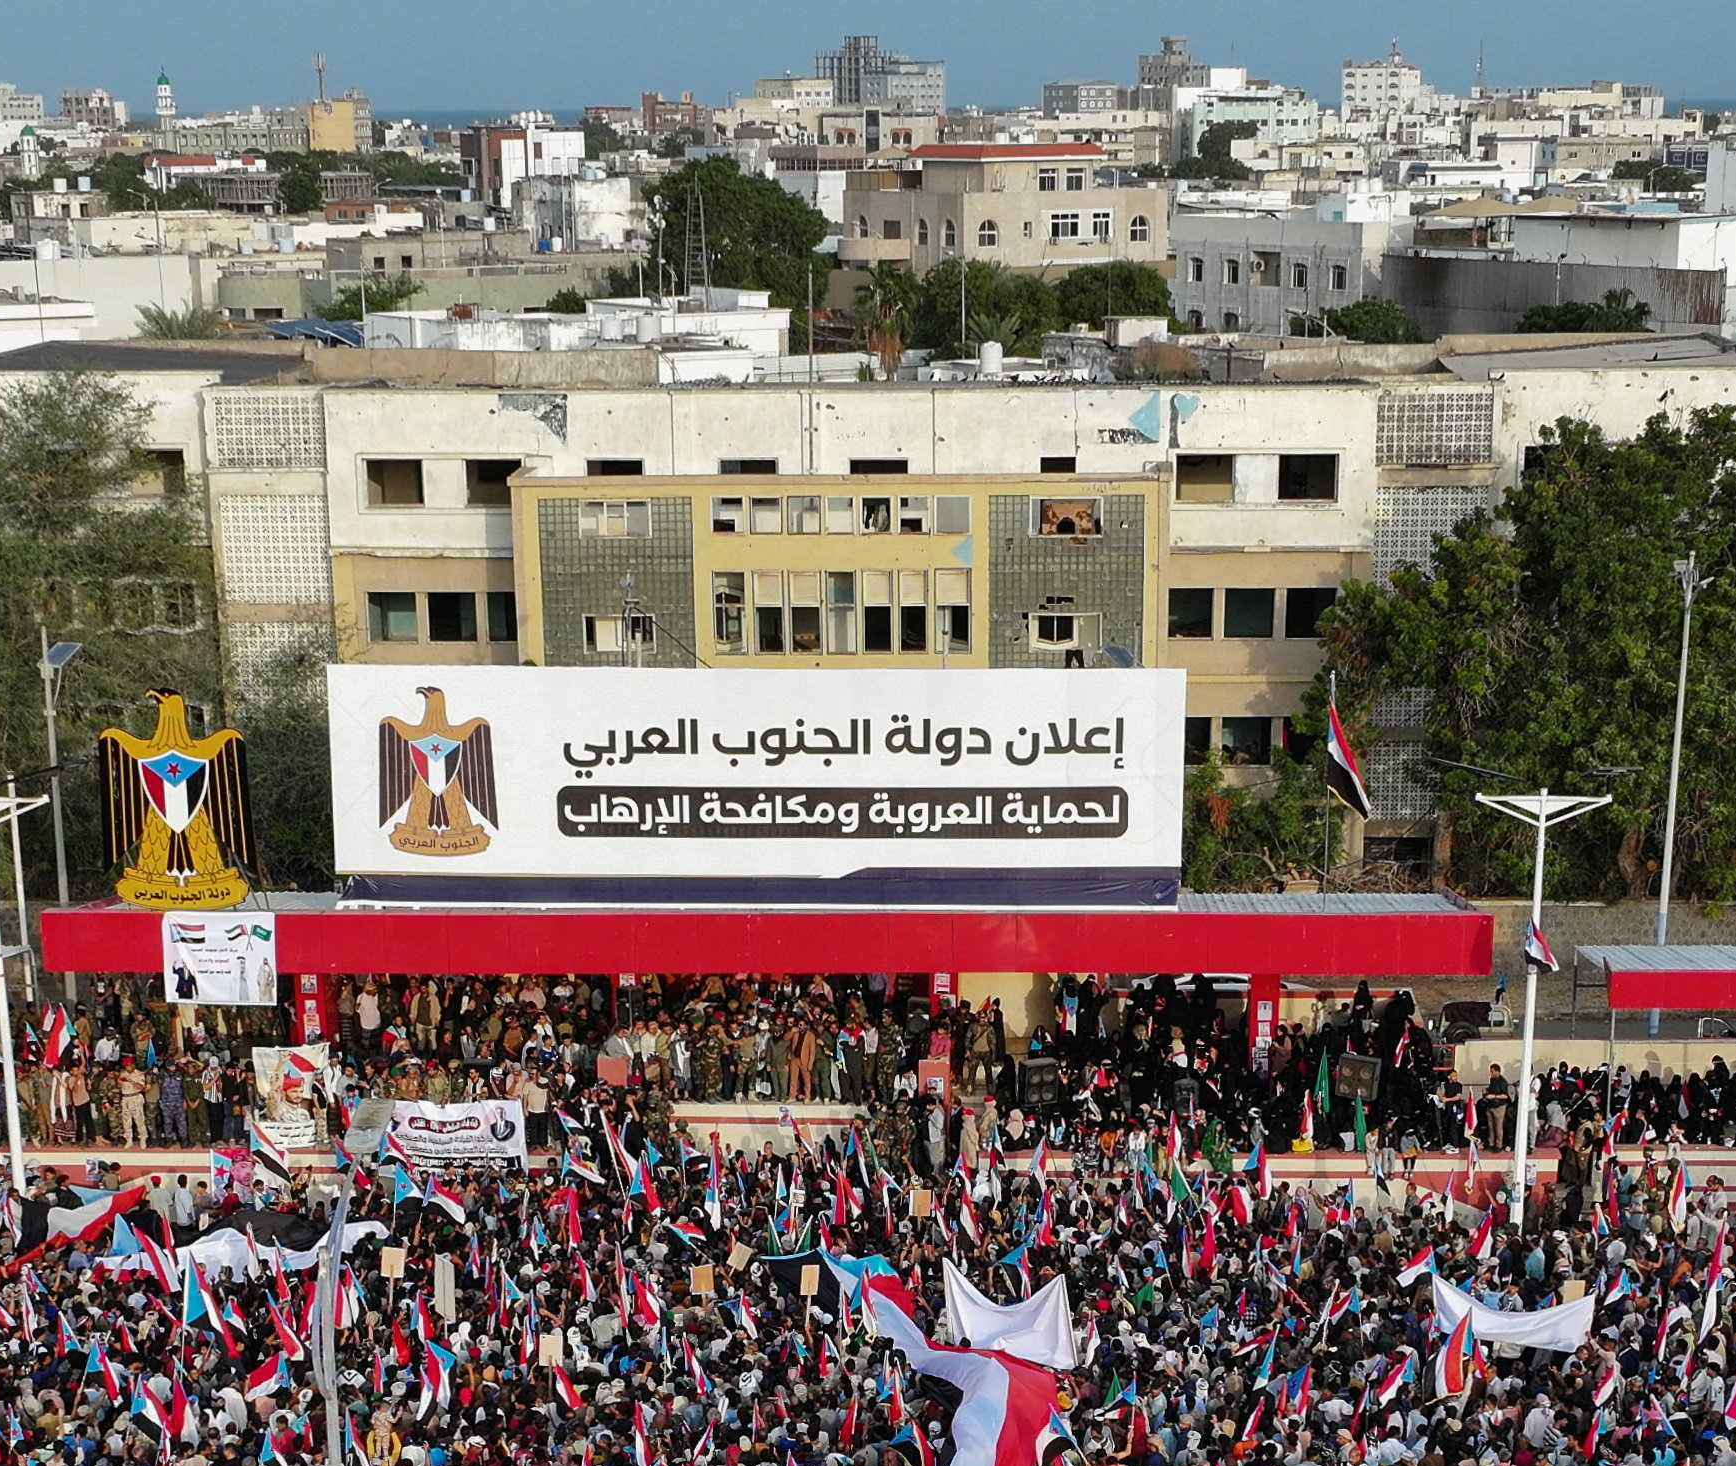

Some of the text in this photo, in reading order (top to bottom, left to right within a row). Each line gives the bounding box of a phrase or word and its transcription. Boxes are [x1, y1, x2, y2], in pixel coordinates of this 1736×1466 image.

[564, 714, 1124, 778] إعلان دولة الجنوب العربي
[564, 792, 1120, 834] لحماية العروبة ومكافحة الإرهاب
[399, 836, 479, 851] الجنوب العربي
[134, 887, 231, 904] دولة الجنوب العربي
